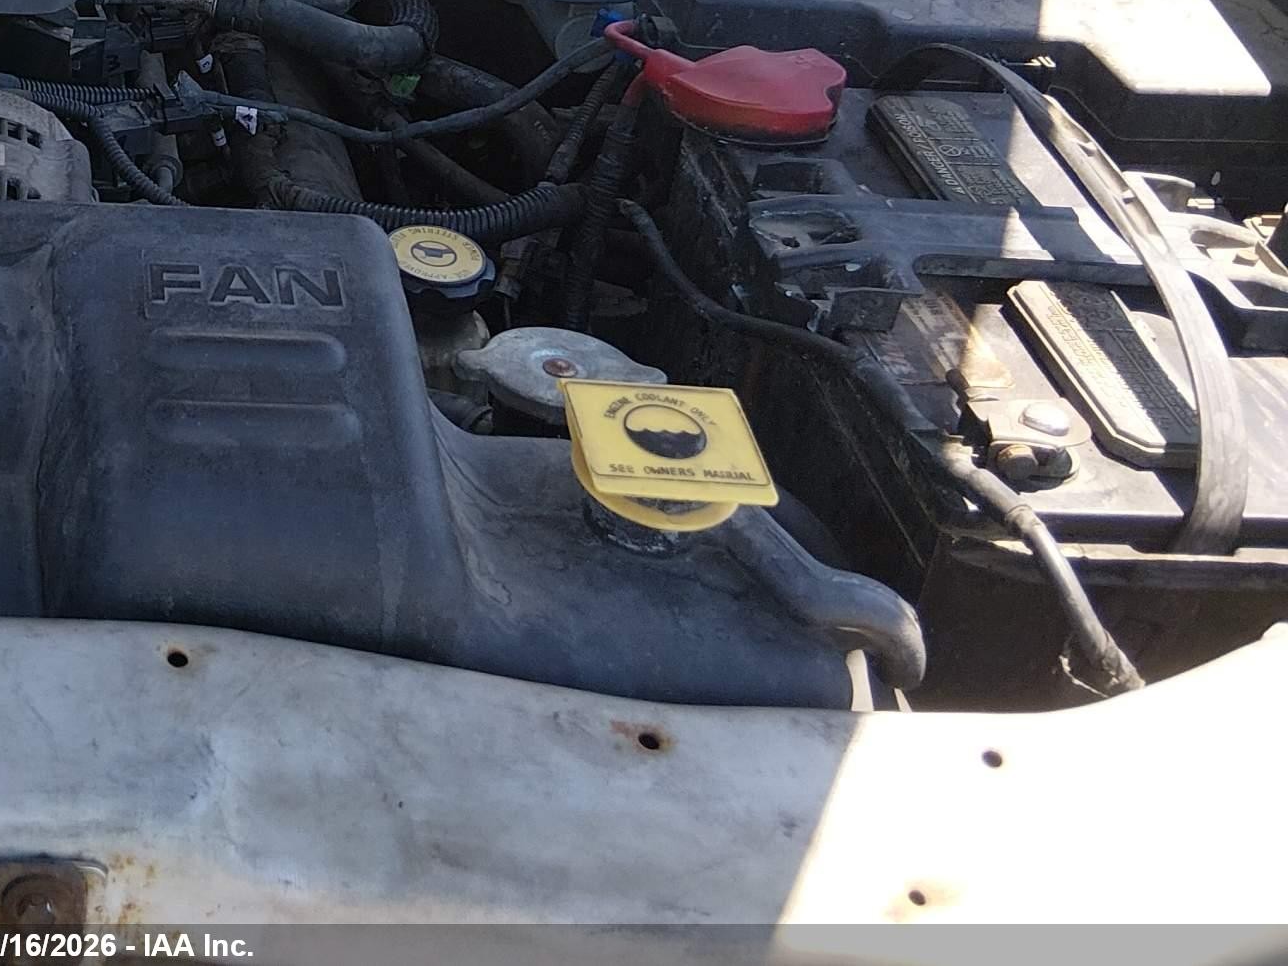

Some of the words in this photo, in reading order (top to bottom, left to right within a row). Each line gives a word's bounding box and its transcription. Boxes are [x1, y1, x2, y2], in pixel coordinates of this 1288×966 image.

[149, 263, 345, 308] FAN
[603, 395, 632, 420] ENGINE
[635, 392, 685, 408] COOLANT
[689, 406, 718, 427] ONLY
[608, 463, 635, 474] SEE
[643, 465, 696, 477] OWNERS
